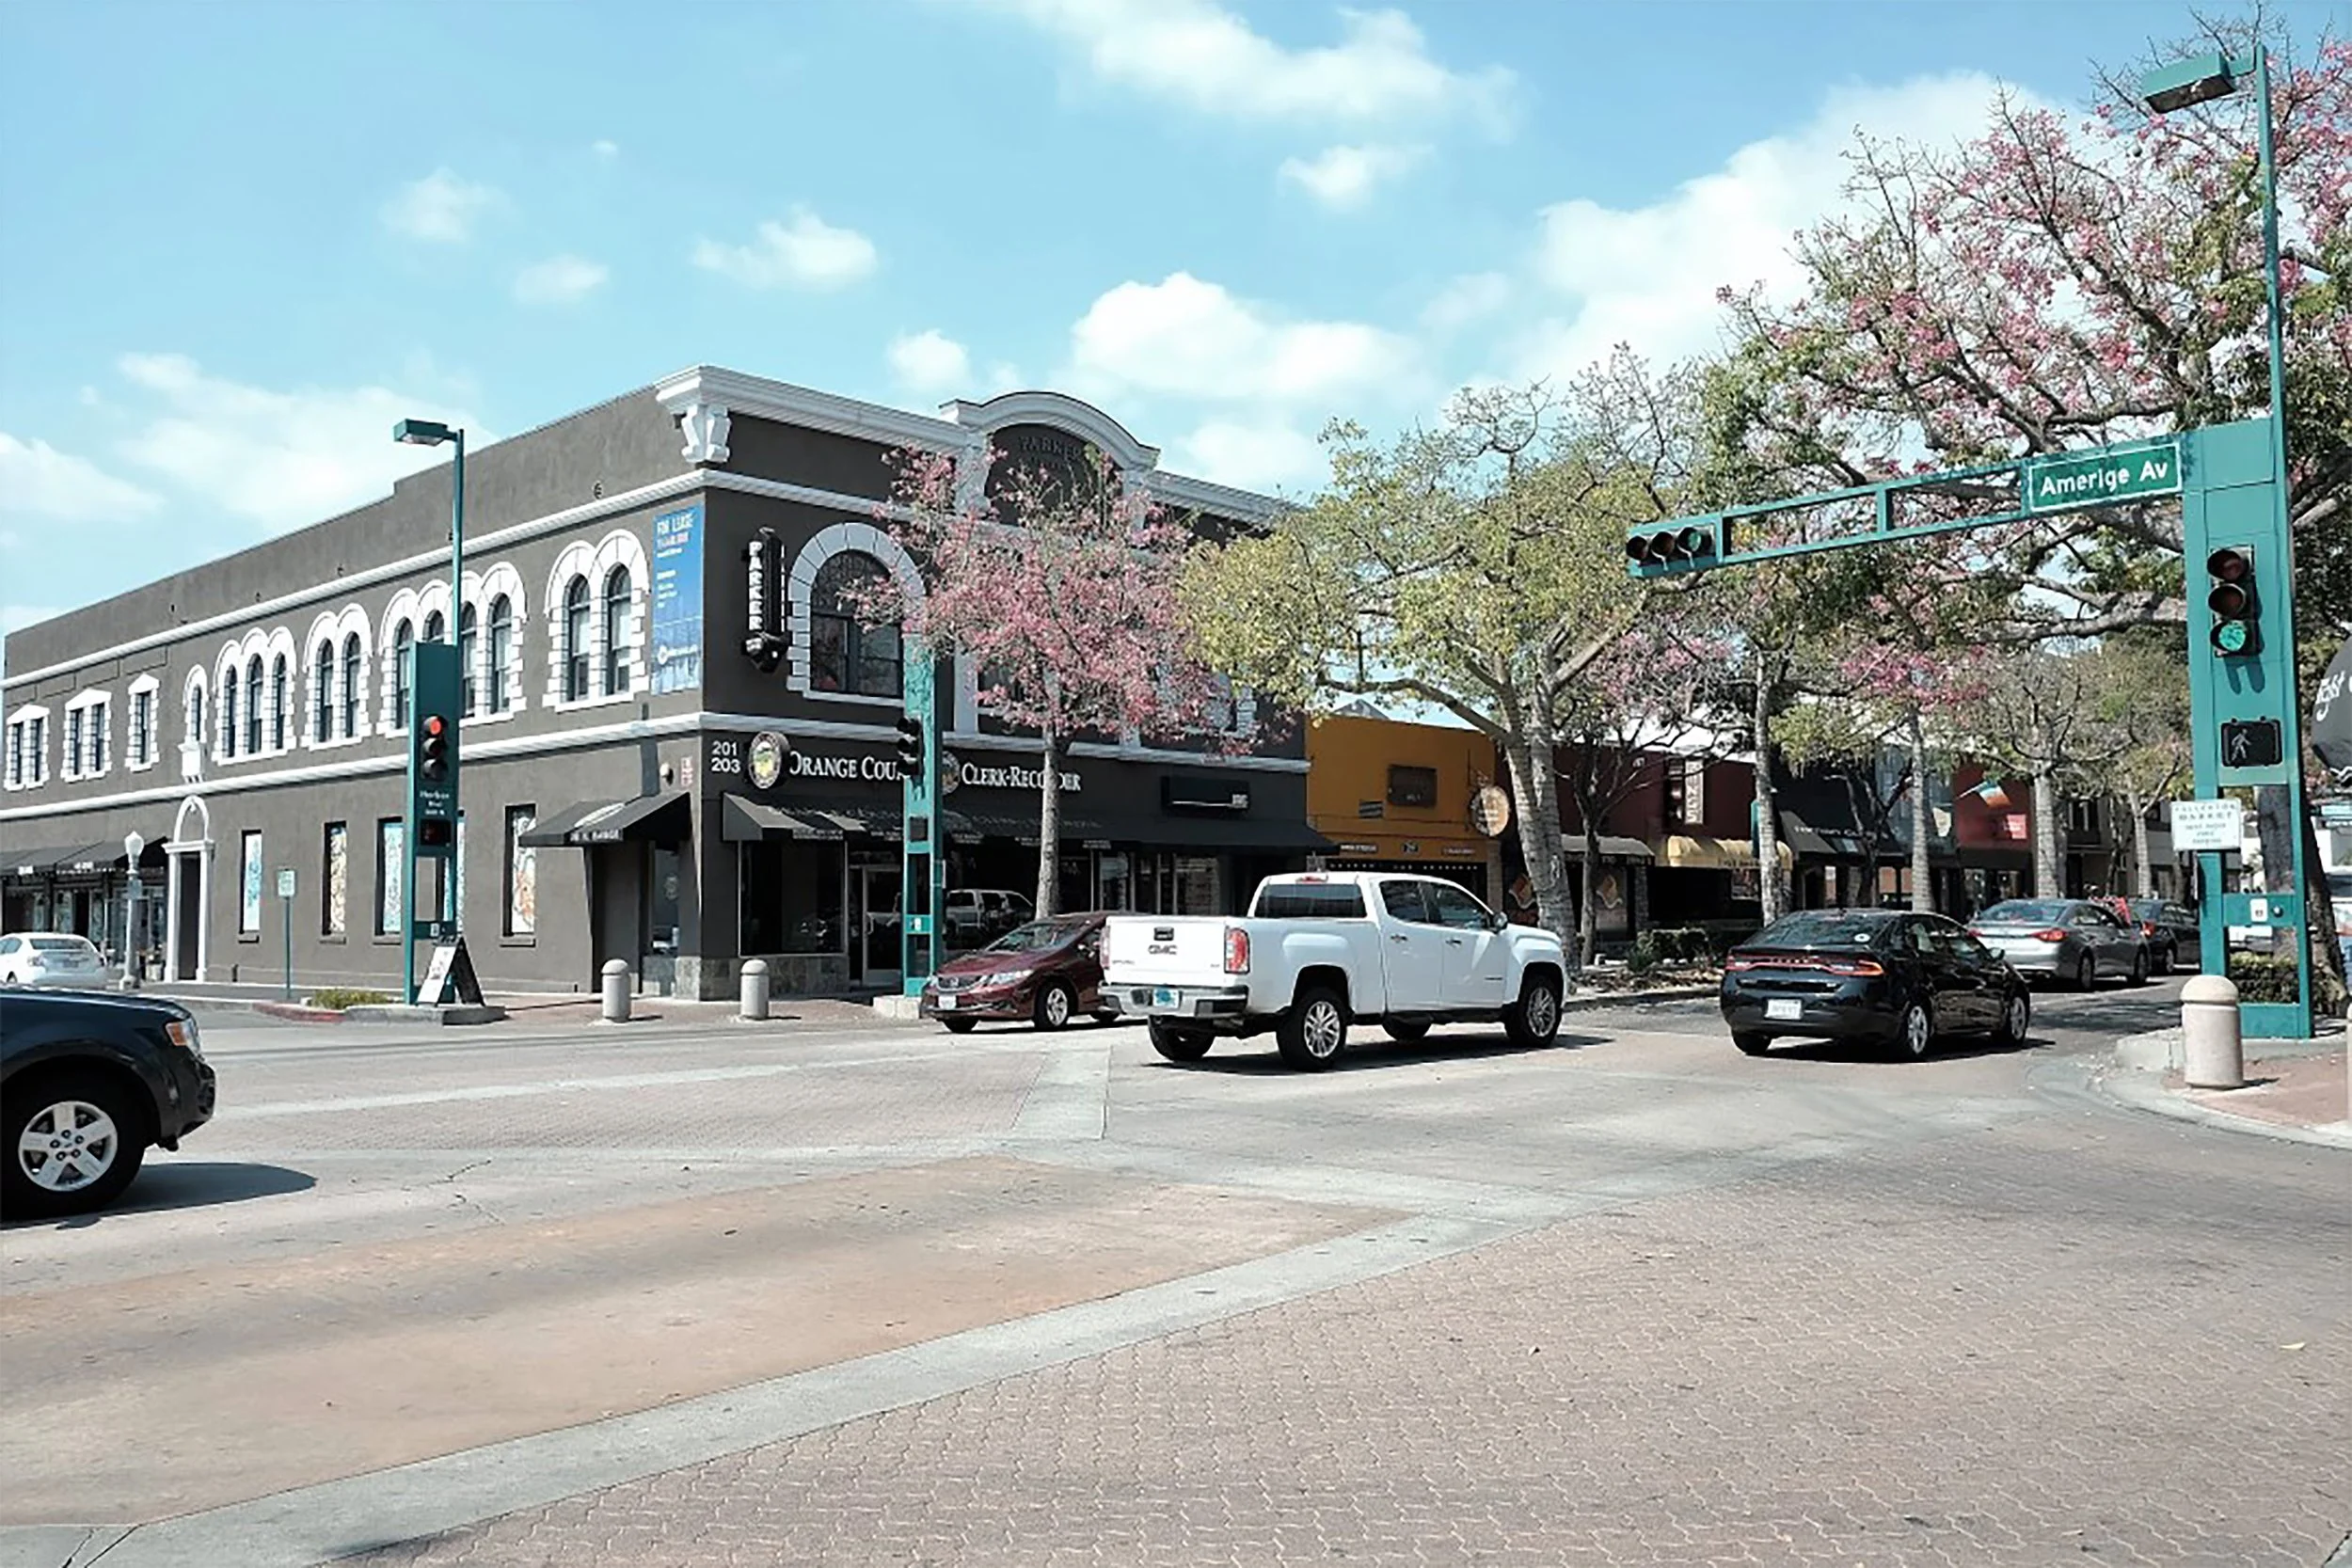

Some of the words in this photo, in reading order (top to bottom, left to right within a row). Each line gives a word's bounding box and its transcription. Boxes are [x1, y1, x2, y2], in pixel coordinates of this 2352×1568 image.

[2041, 467, 2130, 497] Amerige
[2139, 460, 2169, 483] Av
[749, 541, 763, 631] PARKER
[711, 740, 738, 756] 201
[711, 757, 741, 773] 203
[788, 751, 857, 780] ORANGE
[861, 756, 903, 782] COU
[961, 762, 1081, 791] CLERK-RECODER
[1148, 944, 1178, 956] GMC
